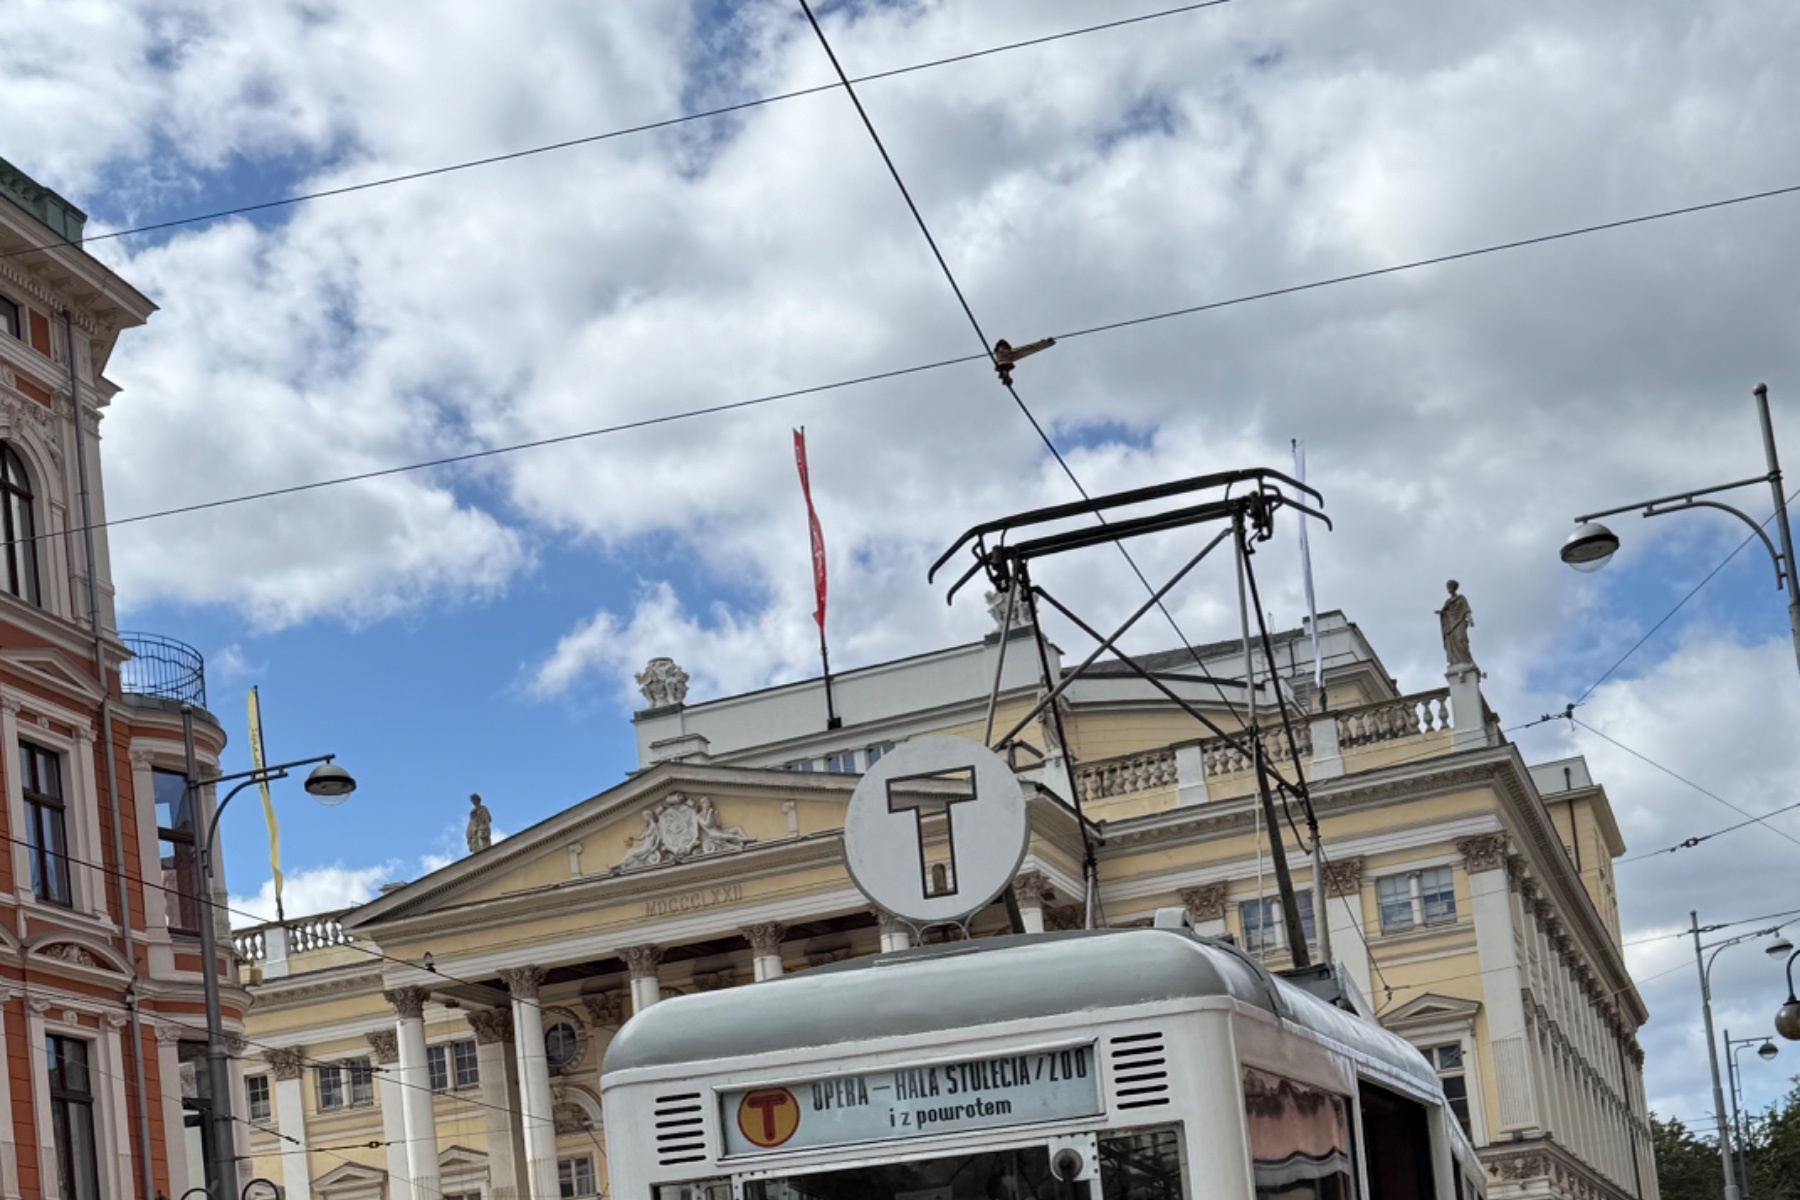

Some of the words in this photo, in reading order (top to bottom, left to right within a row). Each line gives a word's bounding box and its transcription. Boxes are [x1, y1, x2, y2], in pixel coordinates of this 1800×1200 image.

[885, 764, 977, 900] T
[812, 1075, 869, 1111] OPERA
[895, 1067, 940, 1101] HALA
[945, 1056, 1031, 1095] STULECIA
[747, 1093, 787, 1142] T
[889, 1108, 896, 1127] i
[901, 1111, 911, 1126] z
[916, 1097, 1012, 1130] powrotem
